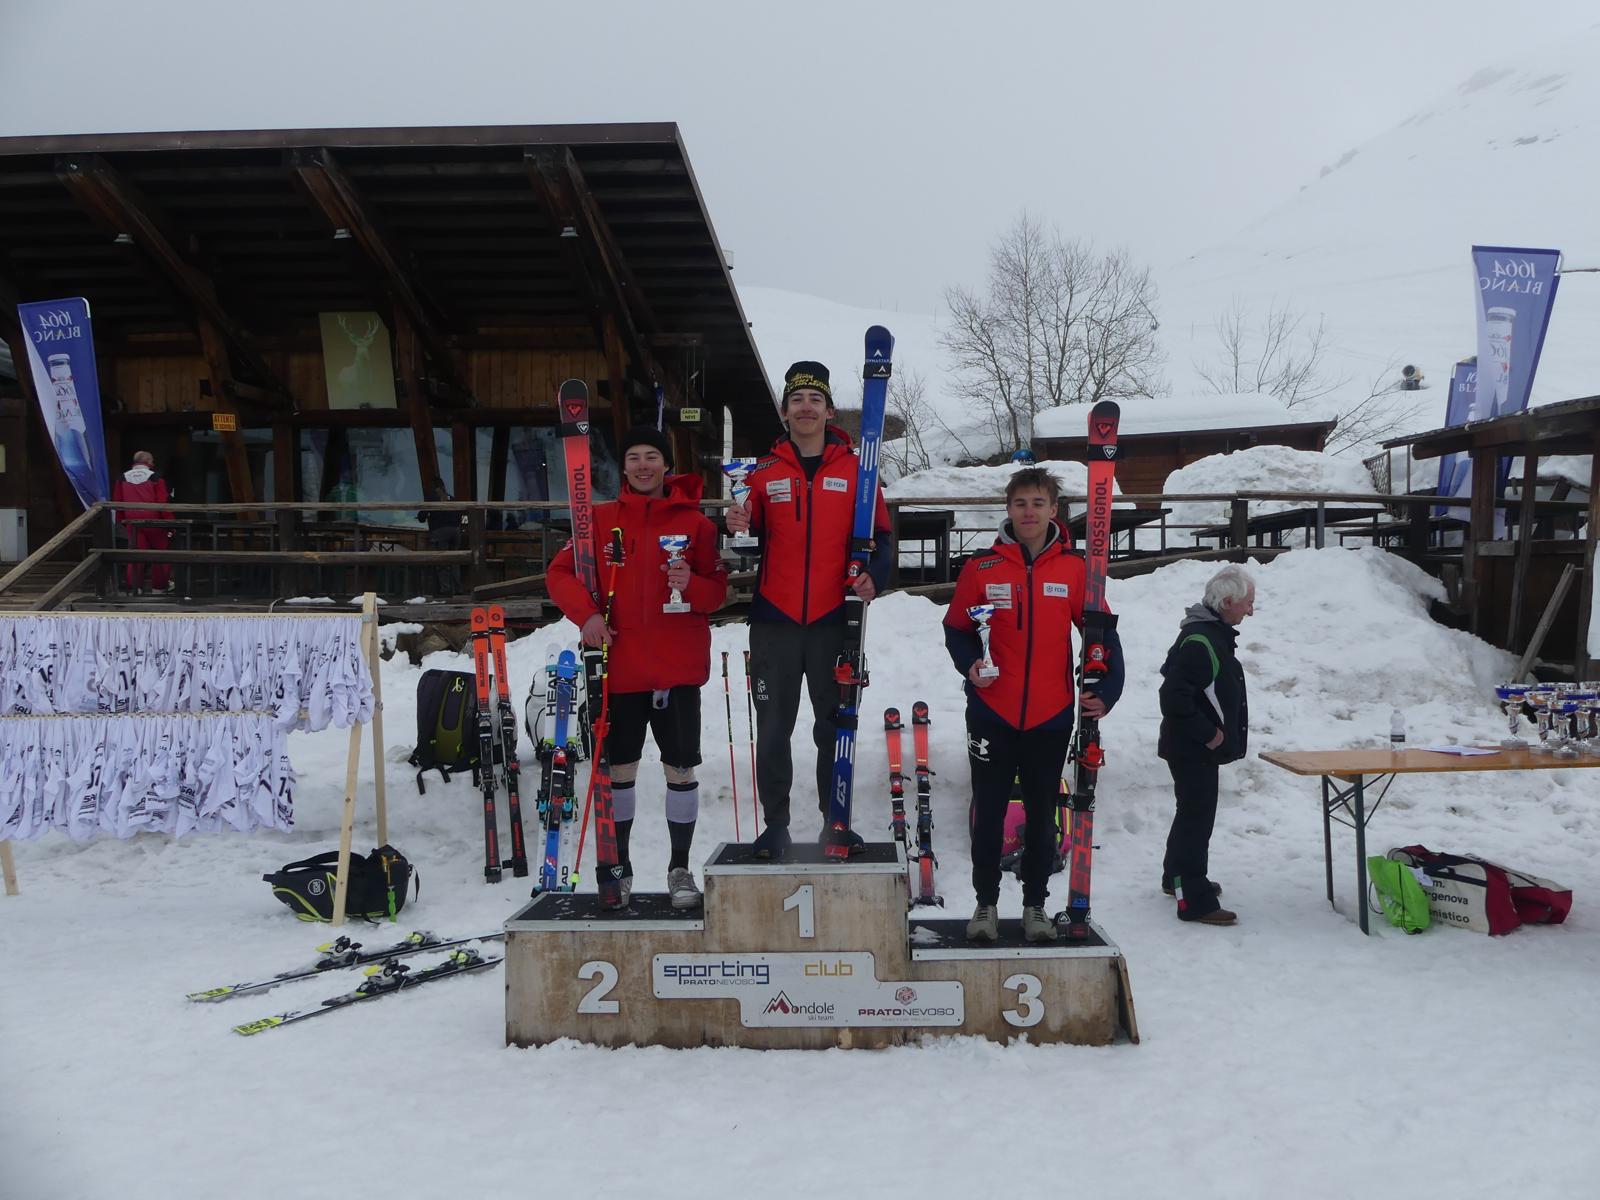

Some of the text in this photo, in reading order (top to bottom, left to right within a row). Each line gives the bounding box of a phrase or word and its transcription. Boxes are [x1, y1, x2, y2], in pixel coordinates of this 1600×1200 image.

[574, 464, 590, 540] ROSSIGNOL
[1092, 477, 1108, 557] ROSSIGNOL
[783, 885, 814, 938] 1
[577, 960, 620, 1014] 2
[663, 960, 853, 985] sporting club
[857, 1007, 955, 1016] PRATONEVOSO
[1001, 974, 1045, 1027] 3
